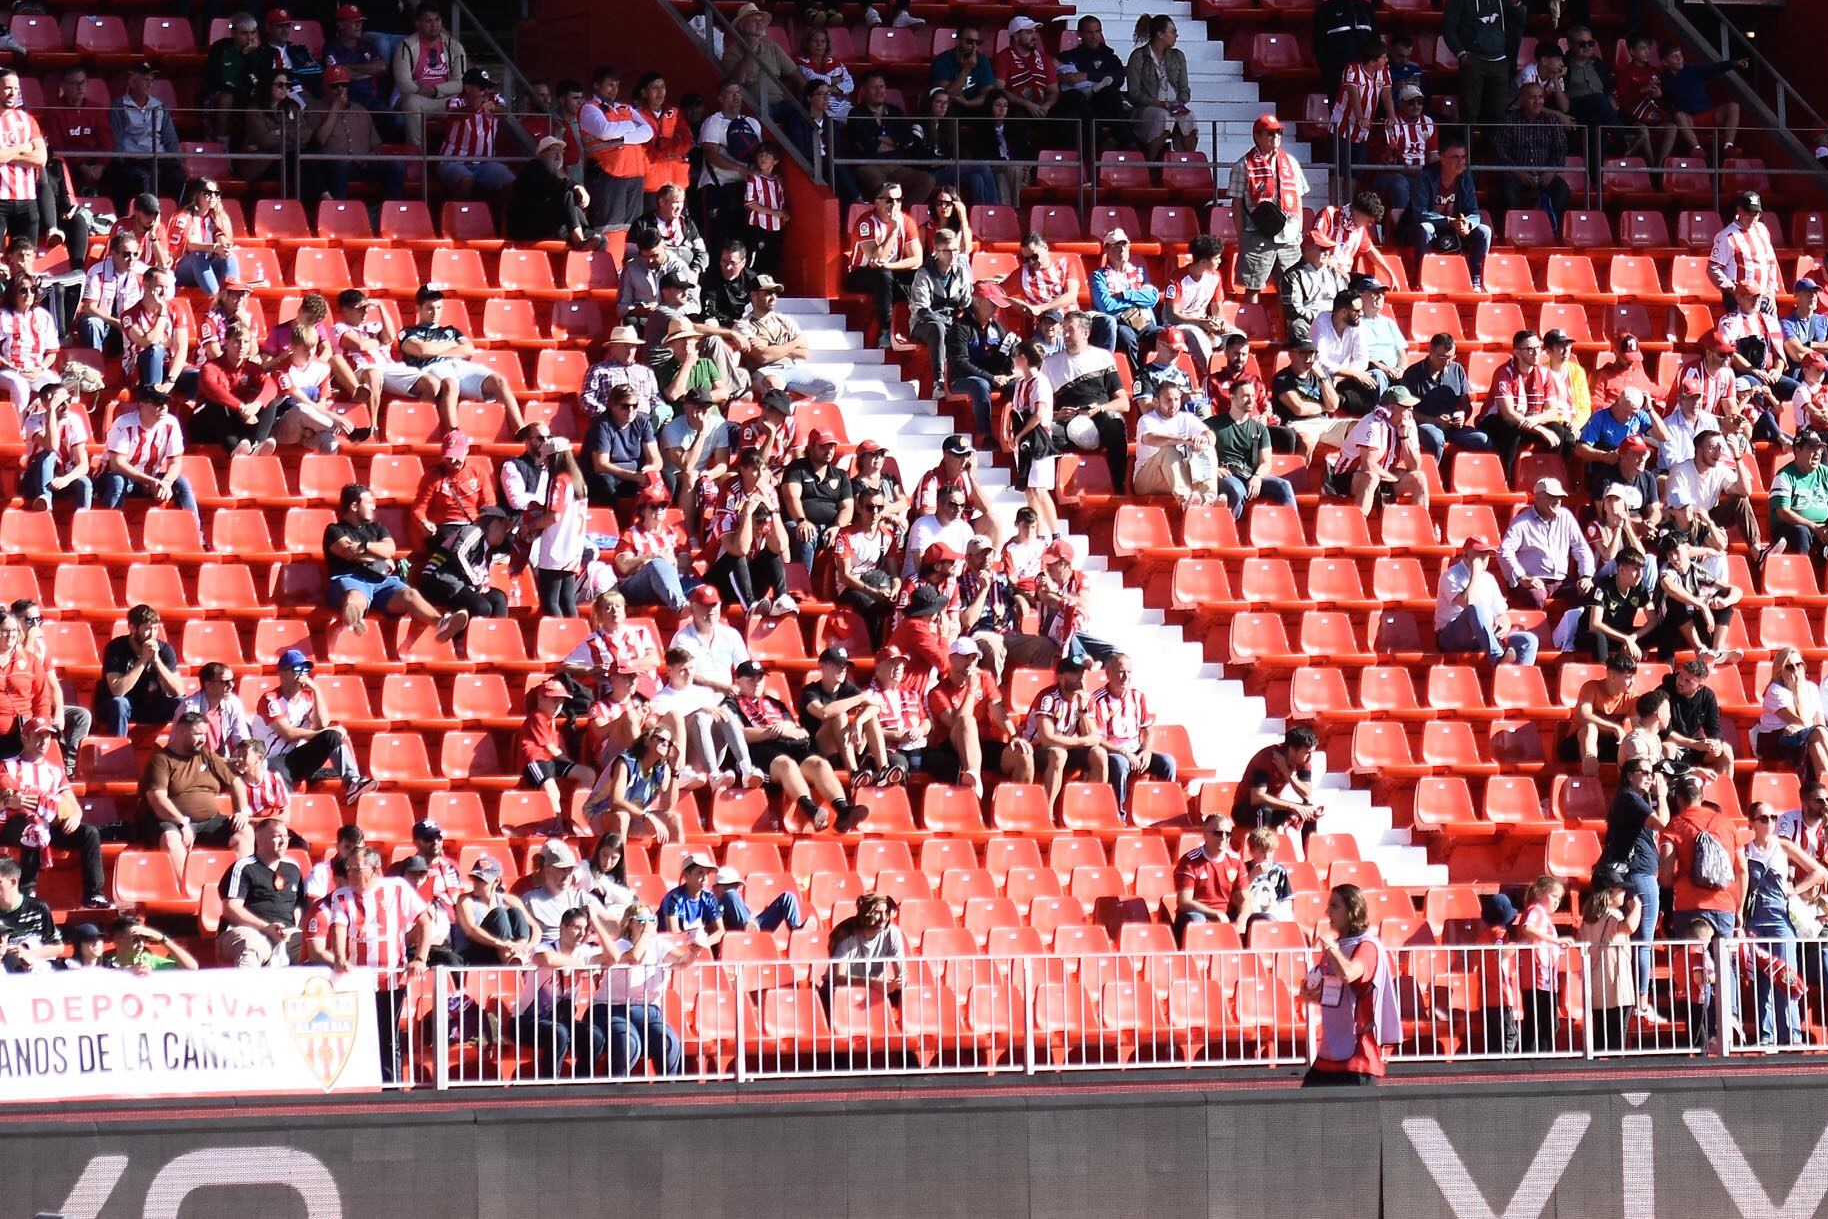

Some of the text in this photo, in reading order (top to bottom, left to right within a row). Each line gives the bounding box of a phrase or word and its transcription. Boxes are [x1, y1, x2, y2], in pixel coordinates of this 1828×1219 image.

[31, 993, 267, 1023] DEPORTIVA
[78, 1032, 113, 1074] DE
[121, 1032, 153, 1072] LA
